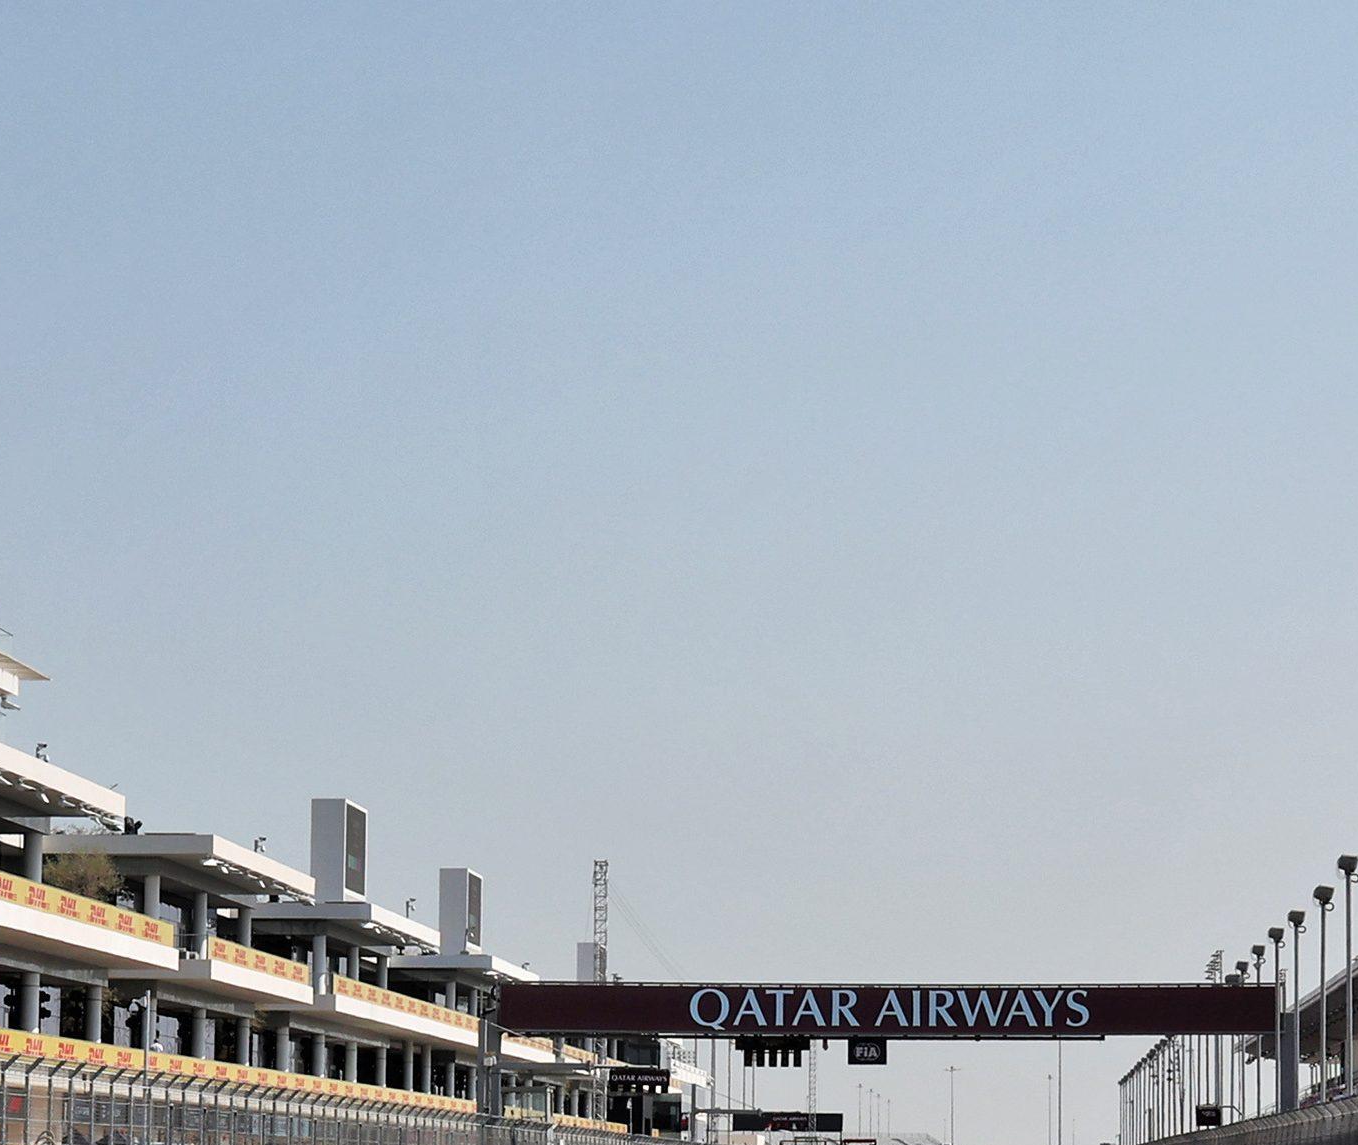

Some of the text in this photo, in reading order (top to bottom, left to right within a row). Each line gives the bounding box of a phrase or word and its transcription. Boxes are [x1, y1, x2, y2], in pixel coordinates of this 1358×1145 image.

[27, 885, 47, 910] DHL
[689, 988, 1090, 1031] QATAR AIRWAYS
[24, 1037, 44, 1056] DHL
[855, 1045, 878, 1058] FIA
[611, 1074, 636, 1082] QATAR
